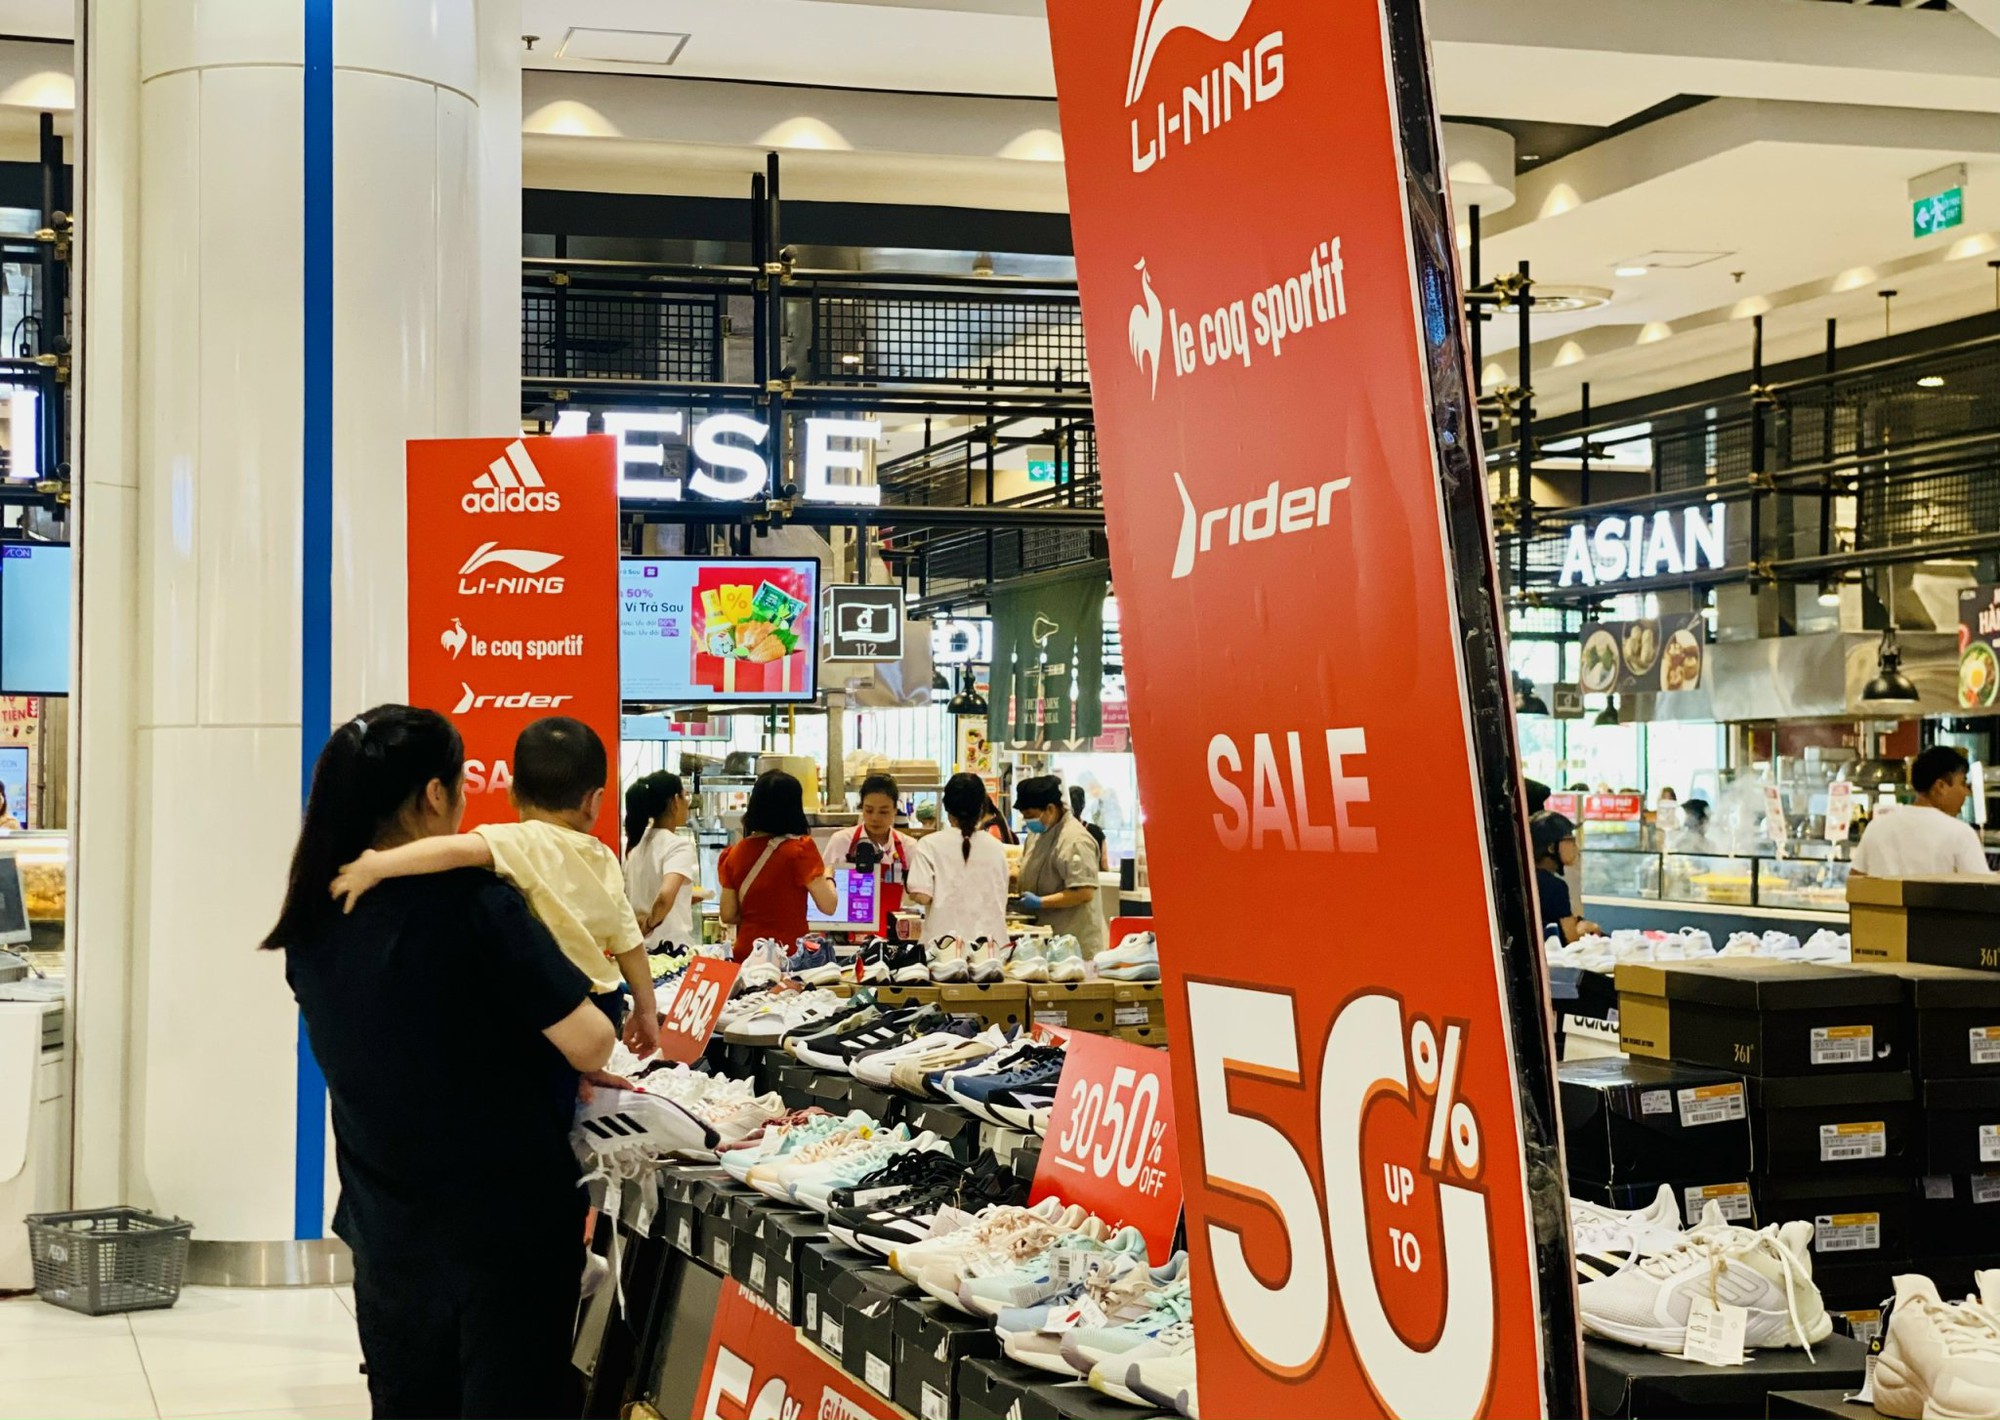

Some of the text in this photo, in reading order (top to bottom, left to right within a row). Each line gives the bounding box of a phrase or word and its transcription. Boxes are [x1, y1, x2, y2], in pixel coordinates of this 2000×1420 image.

[1130, 30, 1285, 175] LI-NING
[1169, 236, 1347, 377] le coq sportif
[461, 486, 561, 514] adidas
[1199, 476, 1352, 552] rider
[1559, 502, 1726, 587] ASIAN
[457, 577, 564, 595] LI-NING
[626, 588, 654, 599] 50%
[661, 601, 684, 612] Sau
[471, 635, 583, 660] le coq sportif
[854, 643, 878, 656] 112
[473, 692, 574, 708] rider
[1207, 727, 1379, 852] SALE
[1138, 1168, 1167, 1198] OFF
[1186, 978, 1494, 1420] 50%
[1384, 1162, 1415, 1206] UP
[1388, 1225, 1422, 1273] TO
